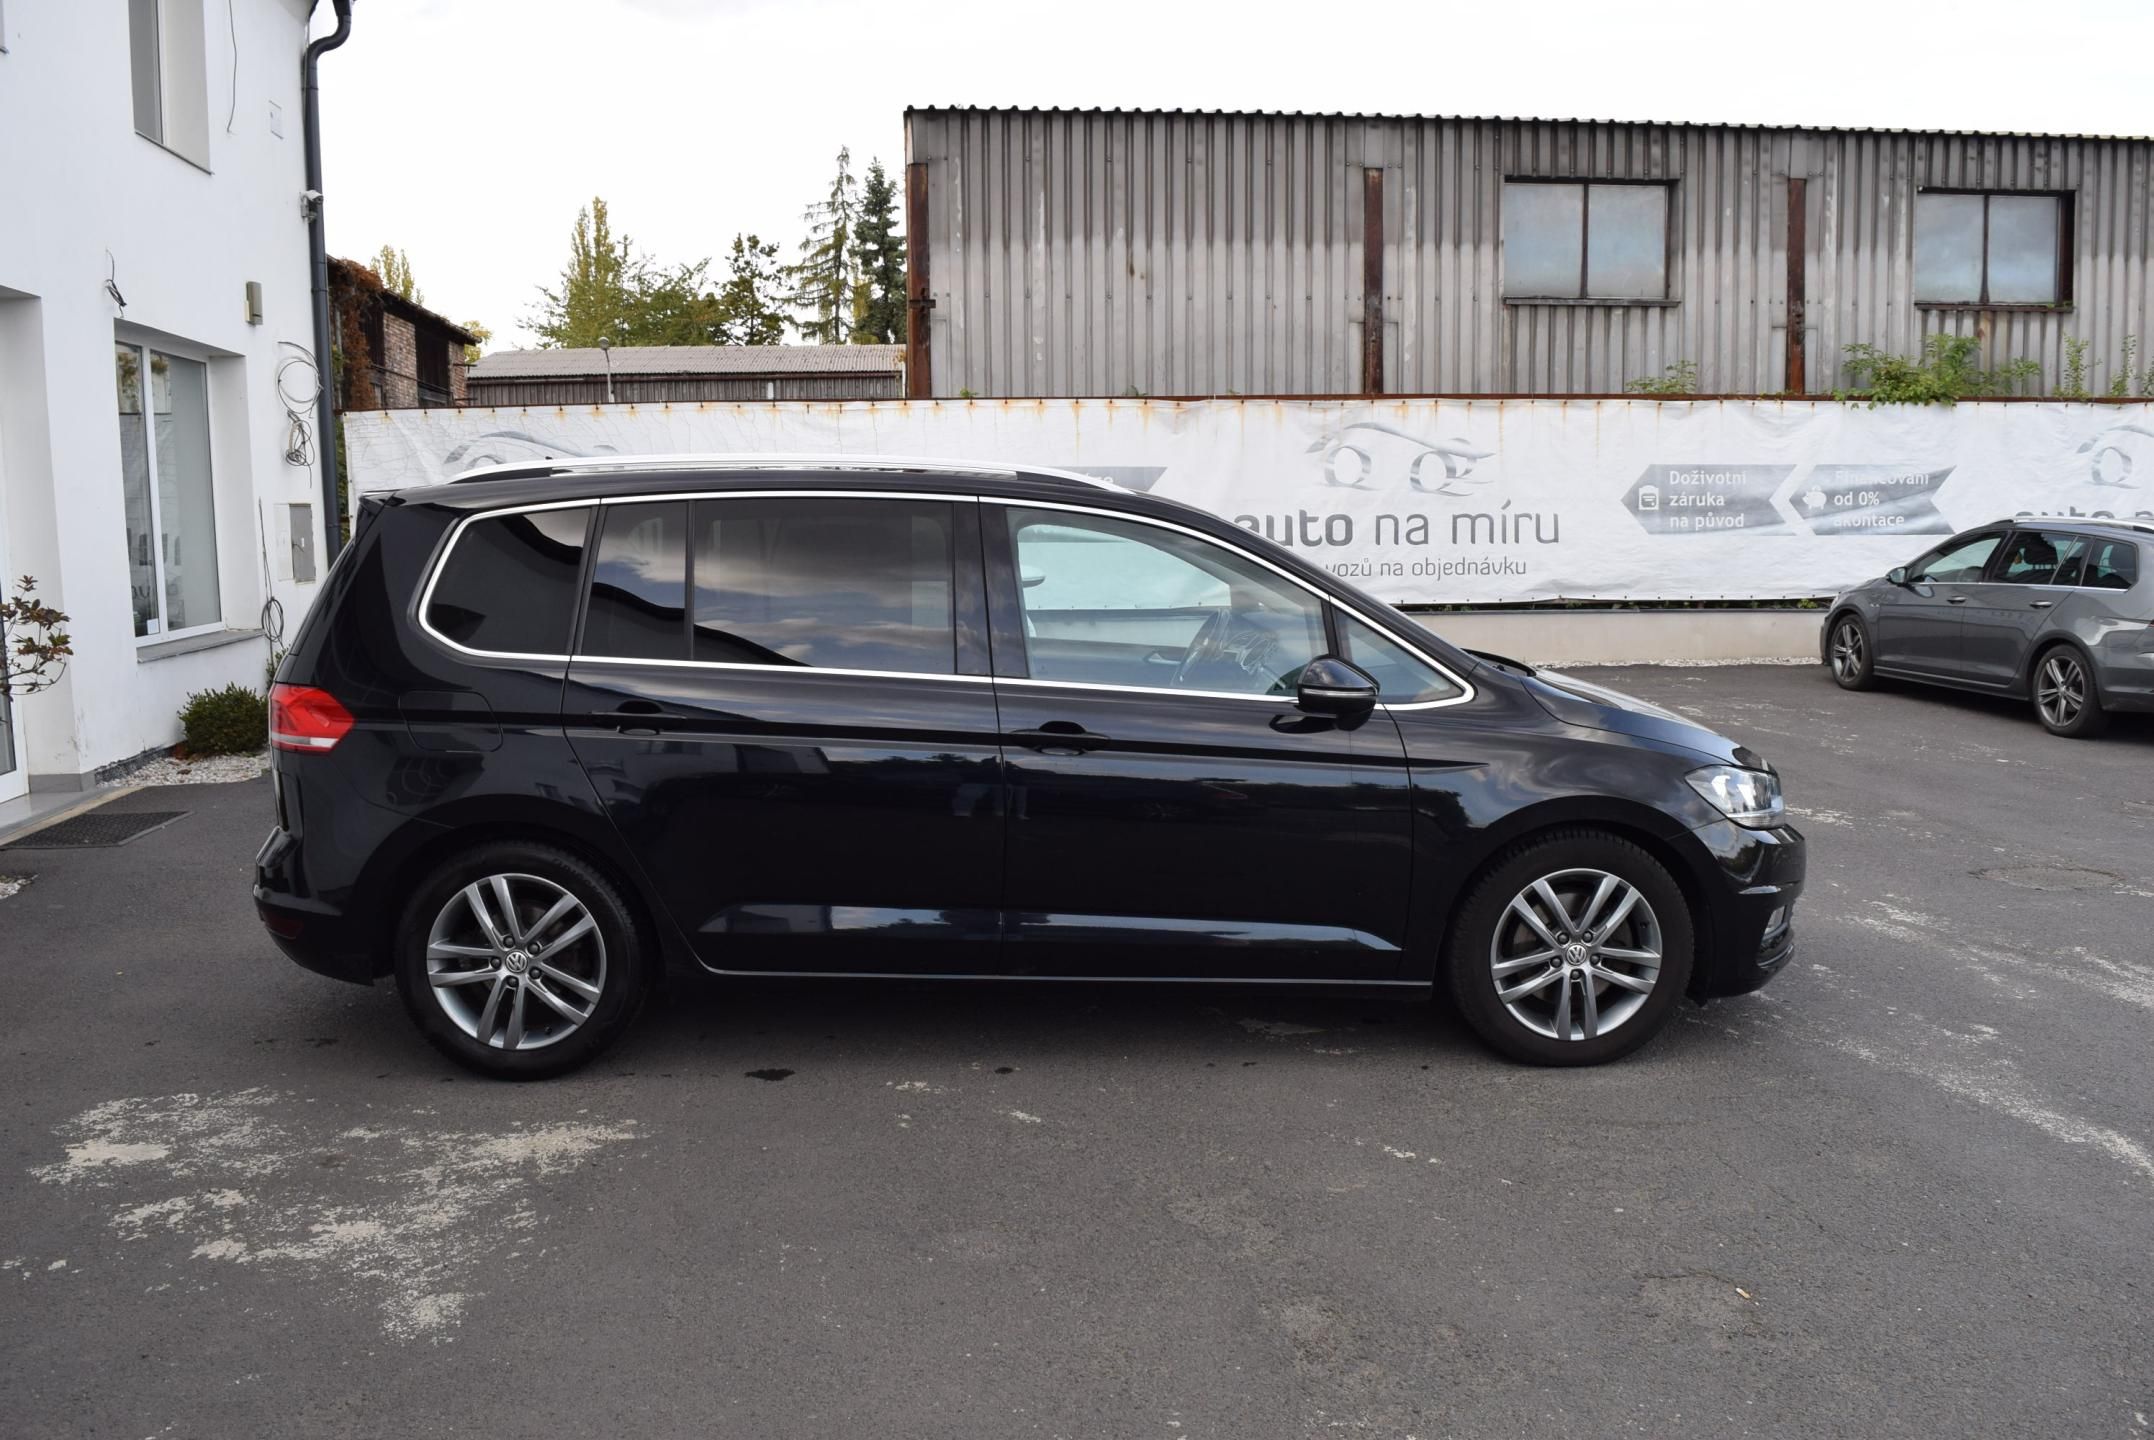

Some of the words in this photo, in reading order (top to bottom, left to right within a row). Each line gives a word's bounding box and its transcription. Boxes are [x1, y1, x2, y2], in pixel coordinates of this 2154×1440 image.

[1669, 470, 1747, 485] Doživotní
[1669, 491, 1725, 506] záruka
[1834, 492, 1853, 506] od
[1858, 491, 1880, 506] 0%
[1233, 509, 1353, 547] auto
[1375, 513, 1429, 545] na
[1452, 498, 1559, 545] míru
[1669, 517, 1689, 528] na
[1695, 511, 1745, 530] původ
[1834, 514, 1905, 527] akontace
[1325, 557, 1372, 577] vozů
[1380, 562, 1404, 576] na
[1411, 556, 1526, 581] objednávku
